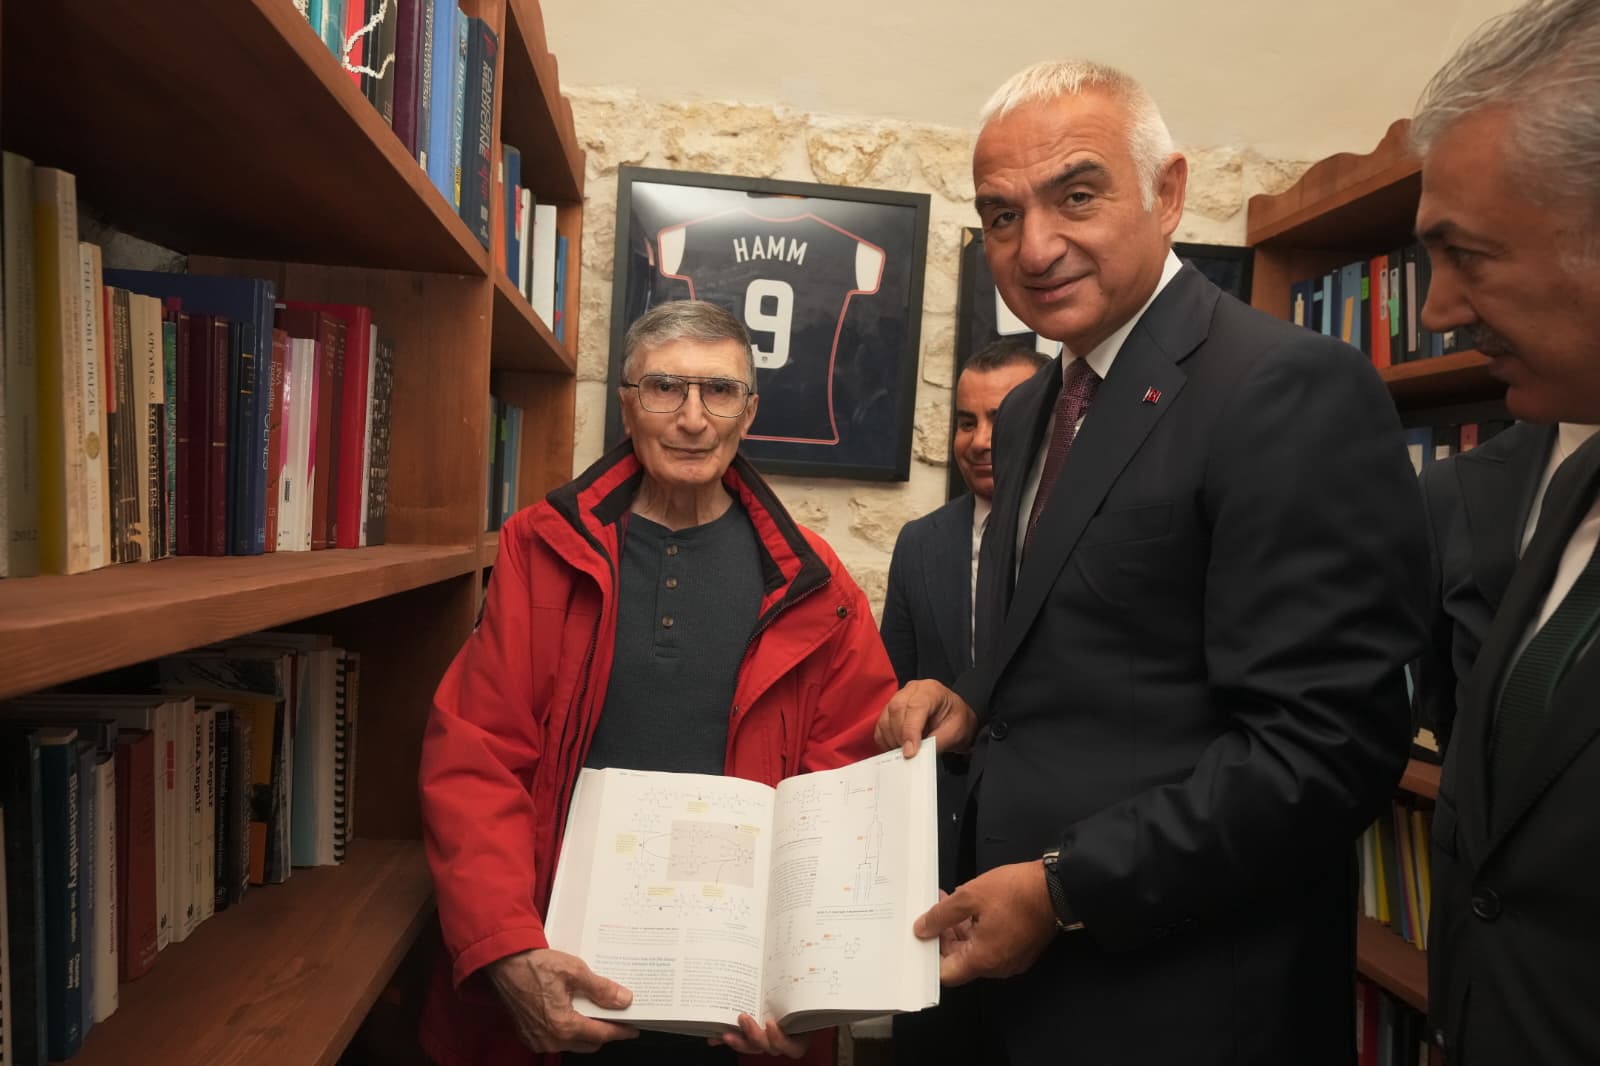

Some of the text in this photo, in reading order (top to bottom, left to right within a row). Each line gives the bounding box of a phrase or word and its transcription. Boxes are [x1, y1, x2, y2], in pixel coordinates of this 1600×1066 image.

[478, 60, 489, 160] MEDICINE
[83, 259, 92, 290] THE
[733, 235, 808, 266] HAMM
[85, 301, 94, 353] NOBEL
[744, 279, 794, 369] 9
[147, 331, 156, 386] ATOMS
[87, 362, 96, 417] PRIZES
[149, 405, 158, 508] MOLECULES
[194, 767, 202, 815] Repair
[206, 761, 214, 809] Repair
[67, 772, 79, 889] Biochemistry
